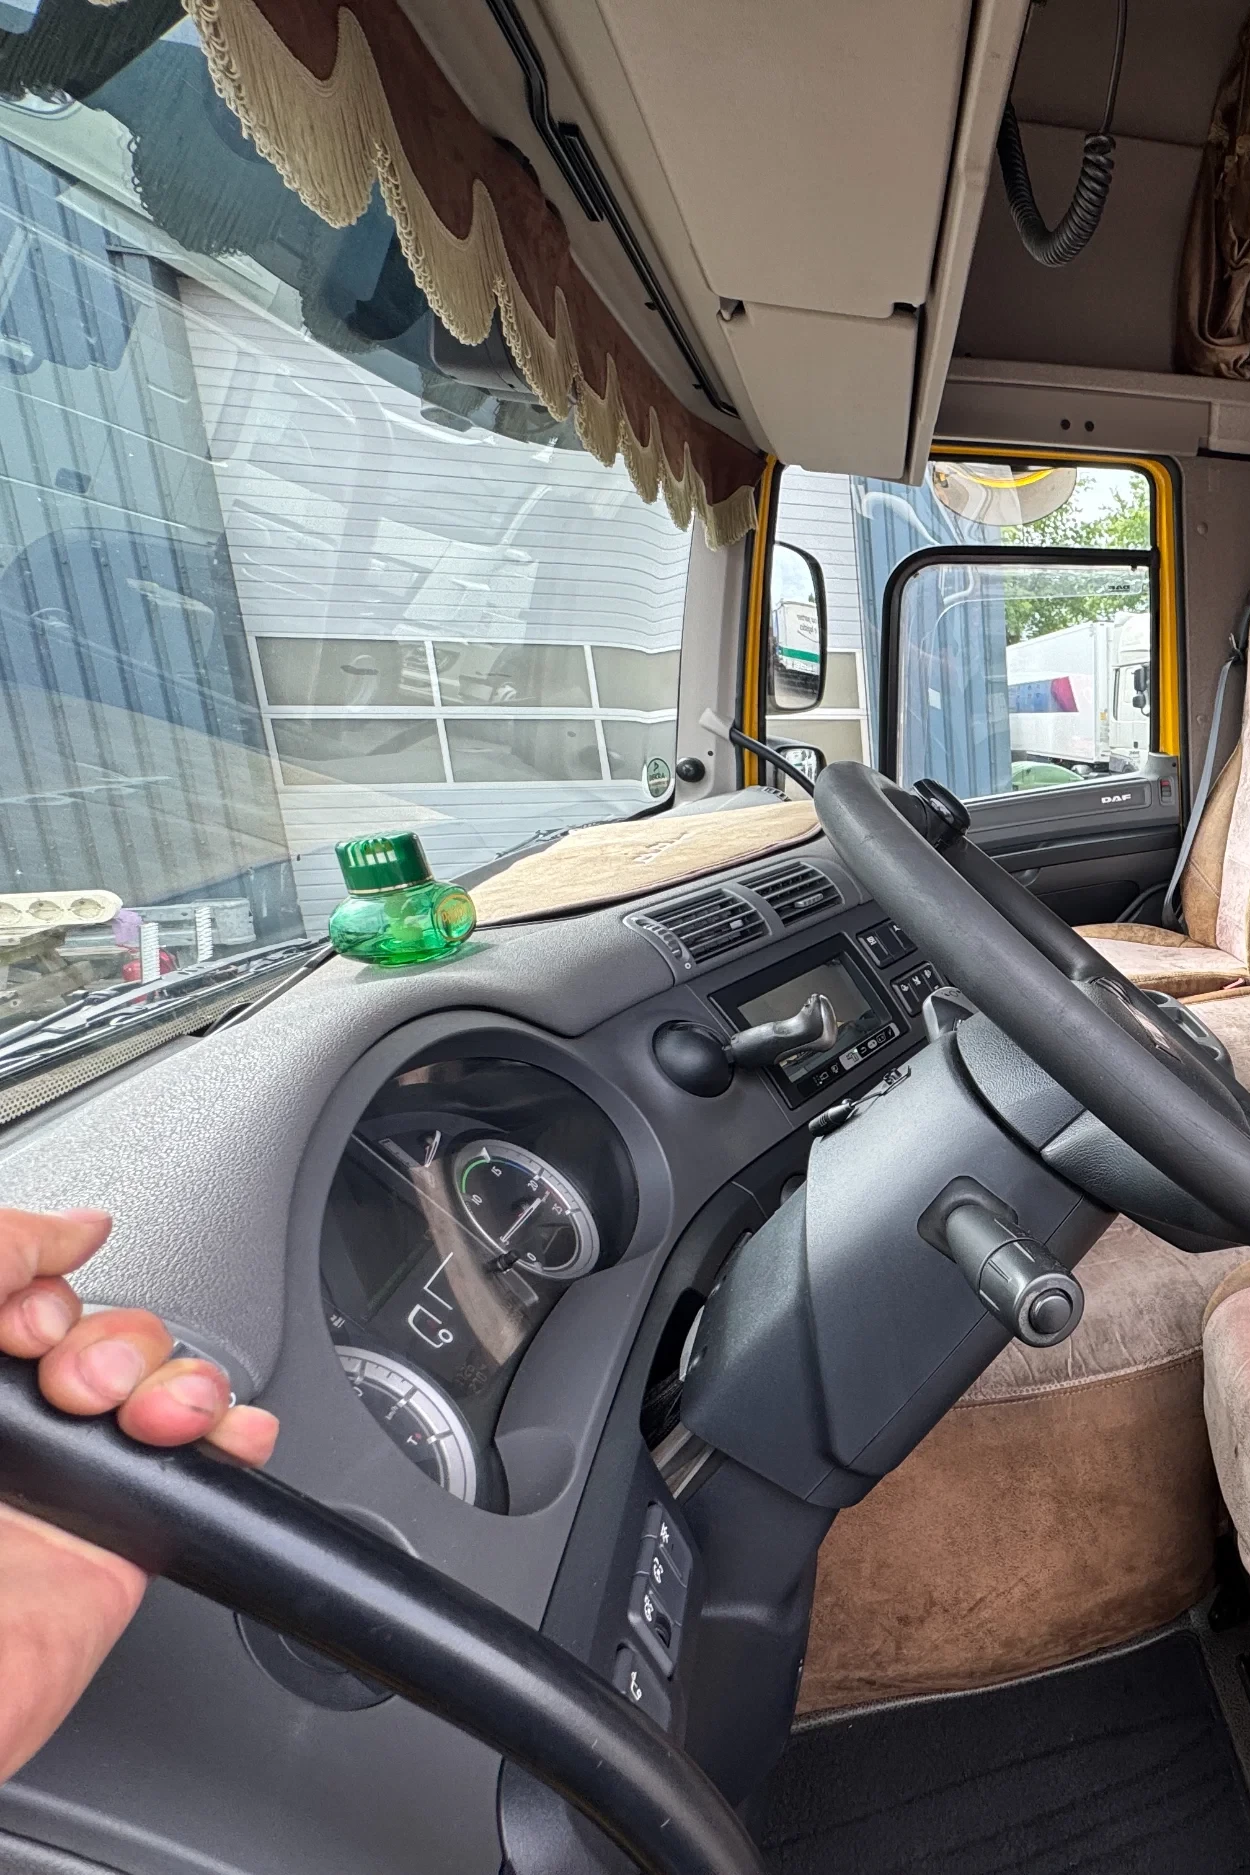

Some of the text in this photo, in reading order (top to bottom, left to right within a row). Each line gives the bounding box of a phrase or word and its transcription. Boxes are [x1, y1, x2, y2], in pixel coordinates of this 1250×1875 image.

[1101, 794, 1132, 804] DAF
[491, 1166, 503, 1178] 15
[527, 1180, 539, 1192] 20
[470, 1194, 483, 1206] 10
